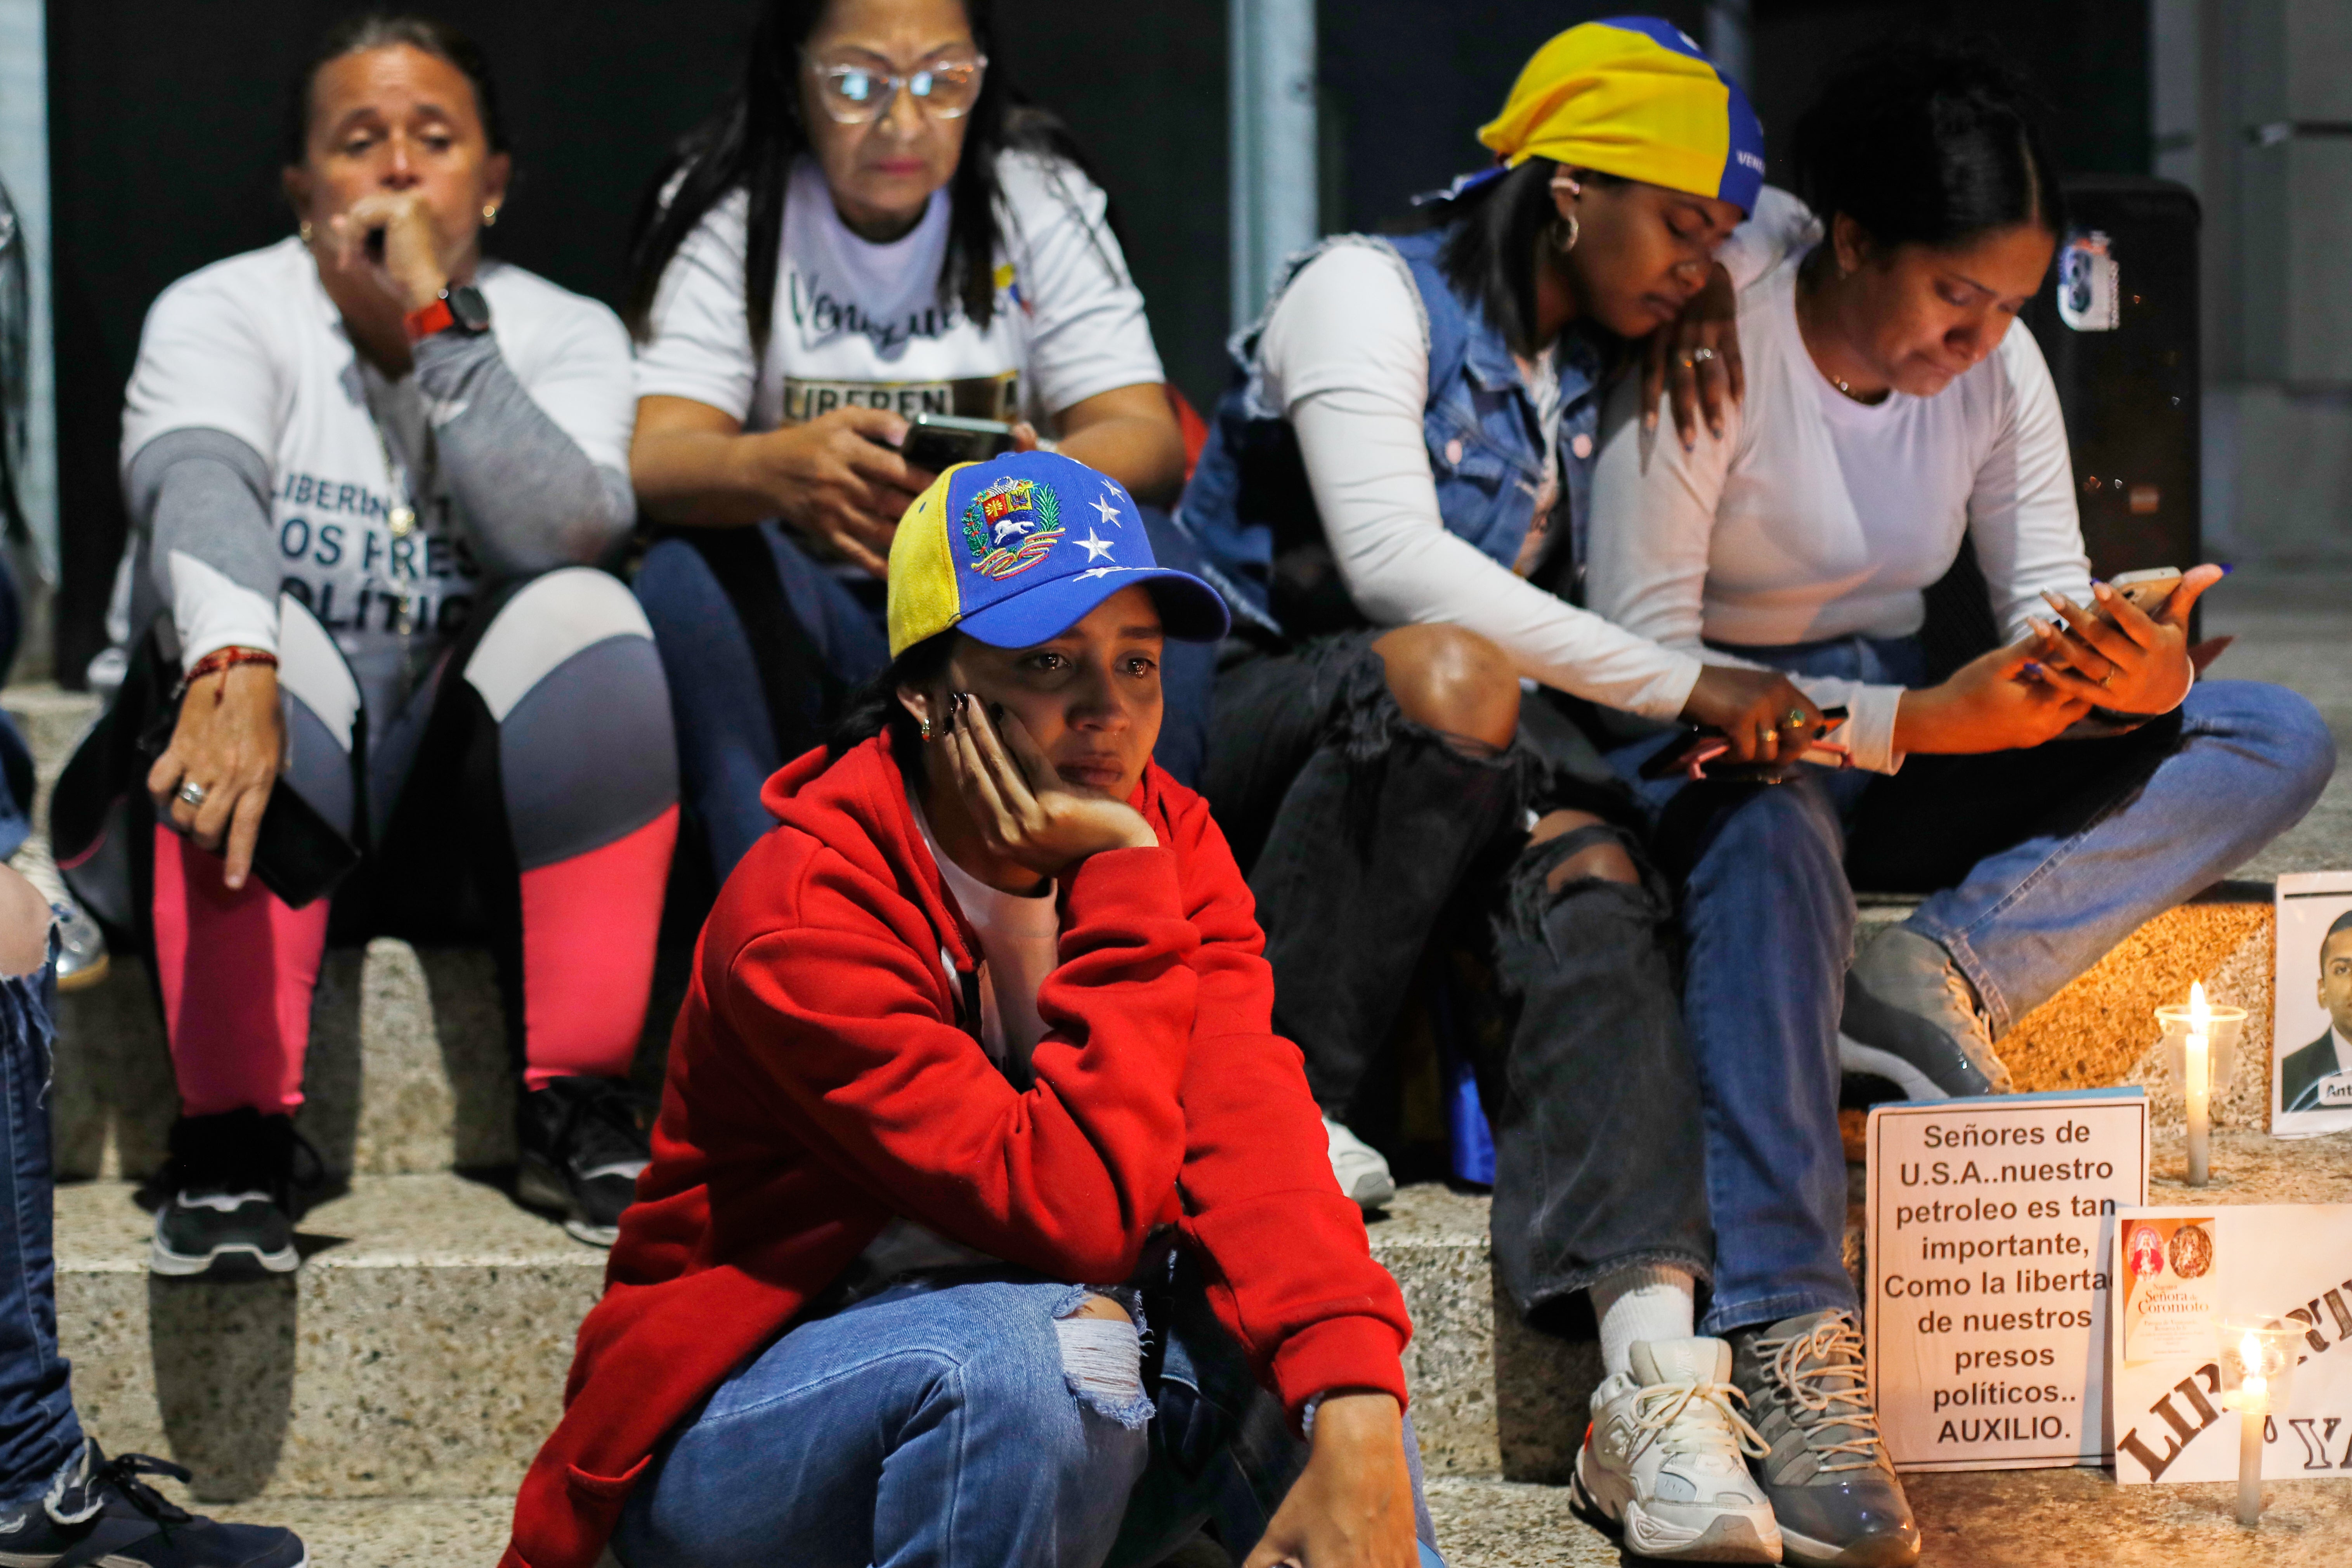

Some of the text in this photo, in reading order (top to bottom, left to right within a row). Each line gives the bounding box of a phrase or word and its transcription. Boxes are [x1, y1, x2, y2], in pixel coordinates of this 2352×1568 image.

[280, 518, 344, 565] OS
[1924, 1120, 2090, 1148] Señores de
[1897, 1196, 2116, 1230] petroleo es tan
[1922, 1233, 2088, 1264] importante,
[1885, 1275, 1970, 1298] Como
[1982, 1271, 2005, 1294] la
[2146, 1290, 2187, 1302] Señora
[1918, 1307, 2092, 1334] de nuestros
[2138, 1300, 2209, 1314] Coromoto
[1955, 1348, 2055, 1375] presos
[1933, 1381, 2076, 1414] políticos..
[1937, 1416, 2071, 1444] AUXILIO.
